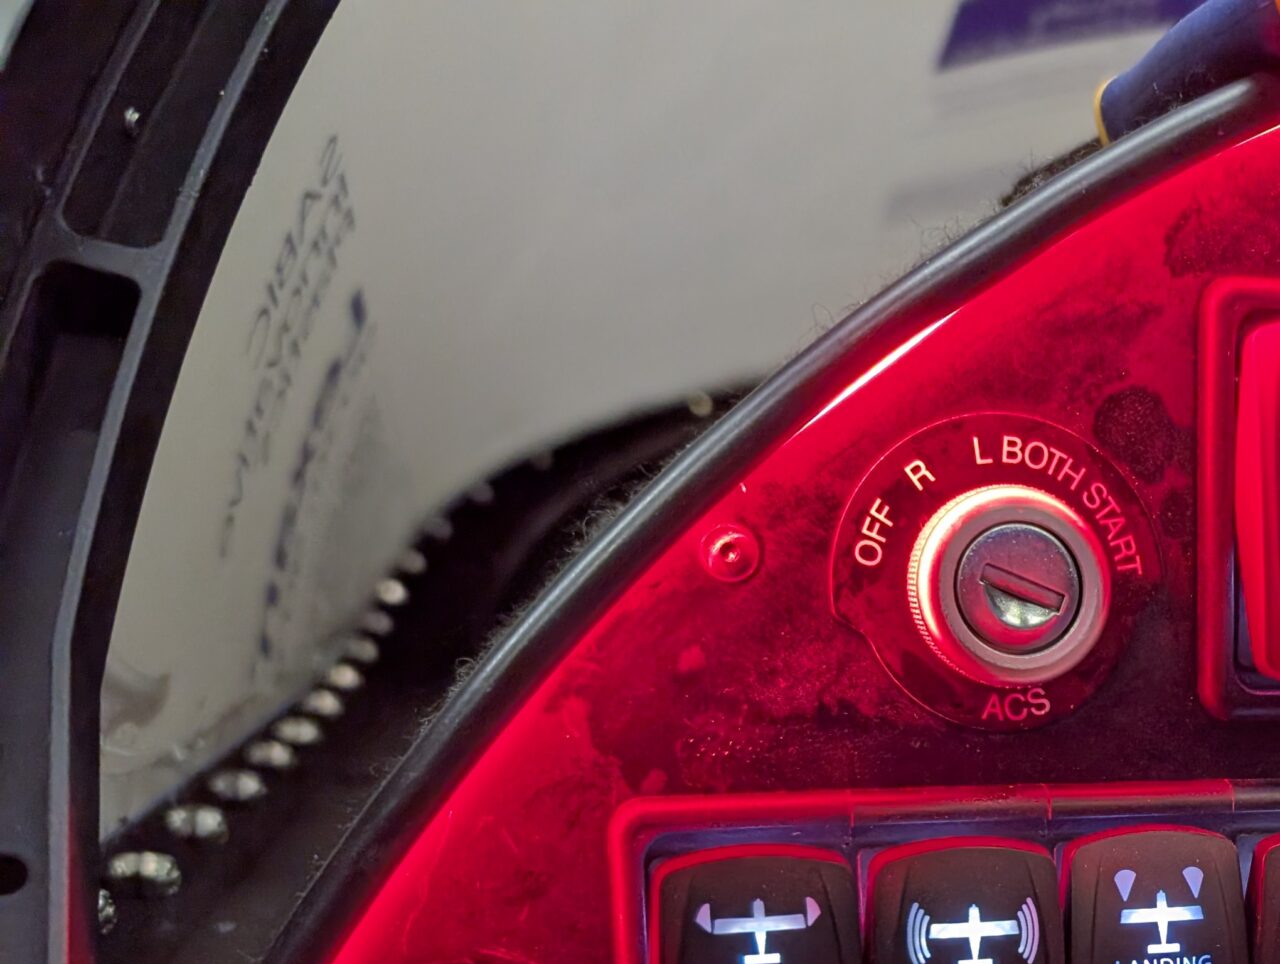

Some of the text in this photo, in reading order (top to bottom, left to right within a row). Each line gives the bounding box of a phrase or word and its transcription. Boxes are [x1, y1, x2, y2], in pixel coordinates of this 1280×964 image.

[854, 435, 1144, 576] OFF R L BOTH START
[981, 687, 1051, 721] ACS
